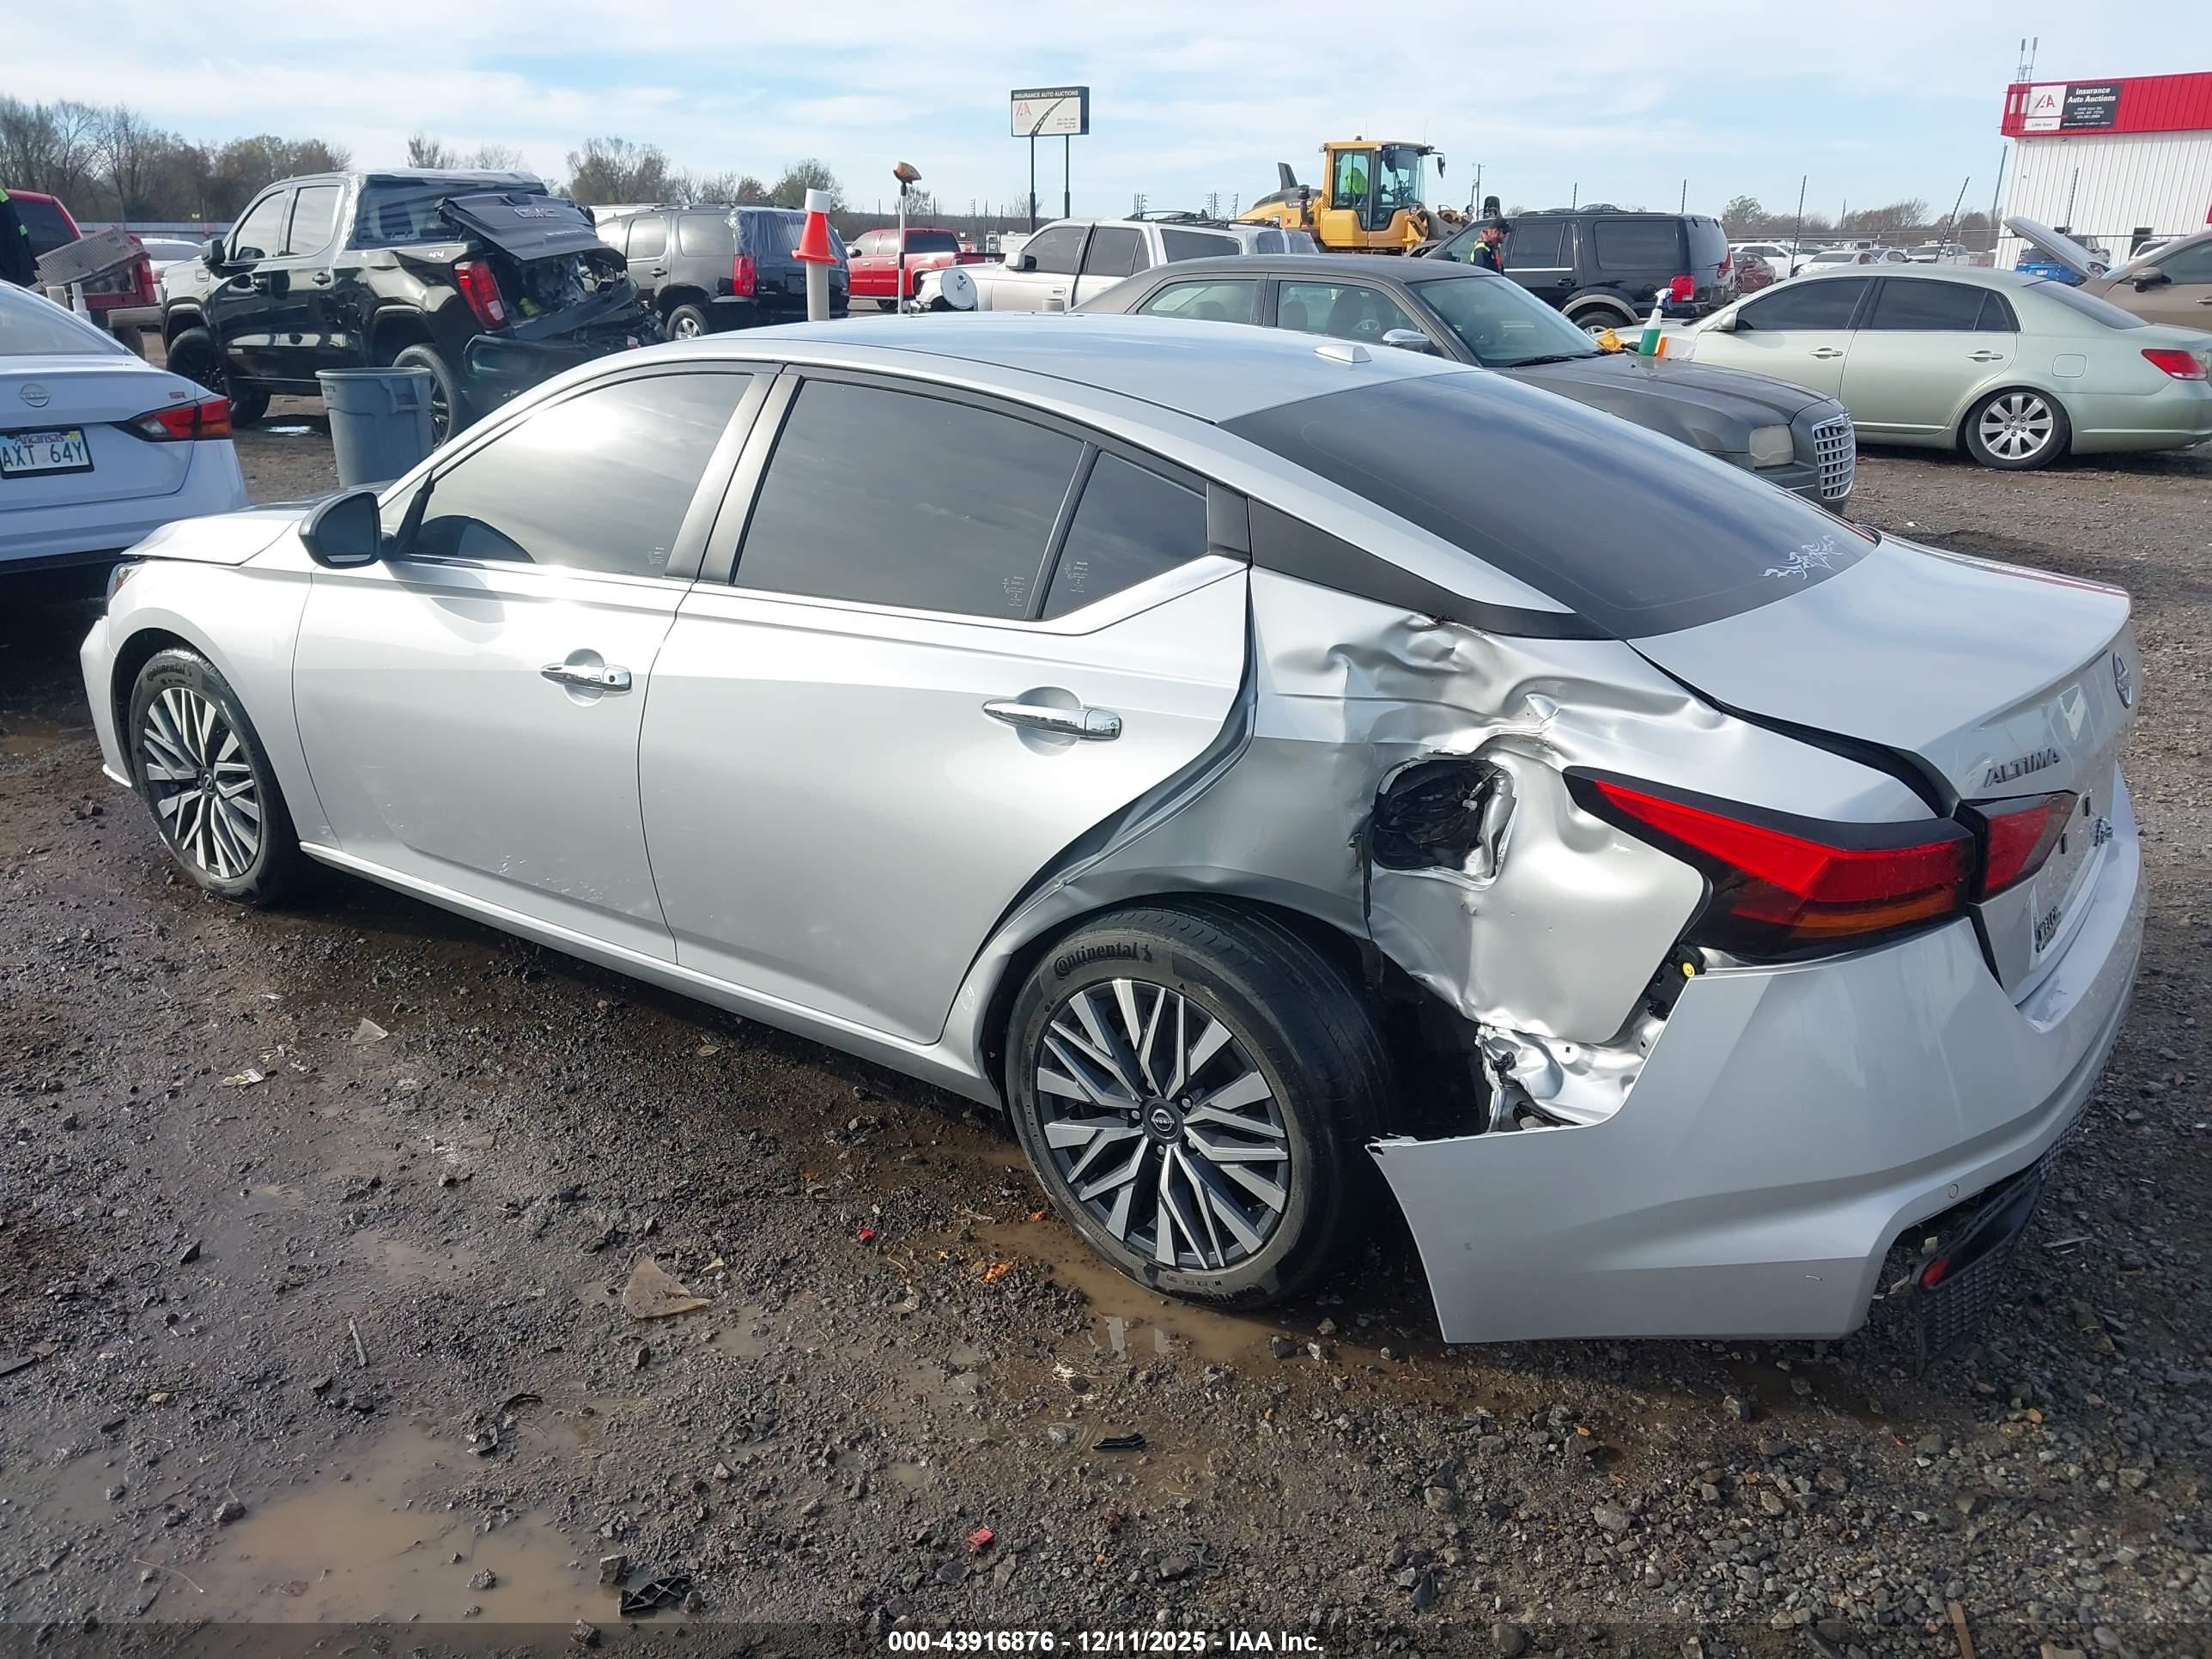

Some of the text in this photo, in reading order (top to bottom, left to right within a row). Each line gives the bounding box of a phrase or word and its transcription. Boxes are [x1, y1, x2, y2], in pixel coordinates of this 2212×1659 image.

[2067, 94, 2117, 104] Auto Auctions
[168, 391, 186, 399] SR
[15, 434, 64, 446] Arkansas
[3, 441, 83, 468] AXT 64Y
[1983, 748, 2061, 788] ALTIMA
[1054, 942, 1139, 977] Continental
